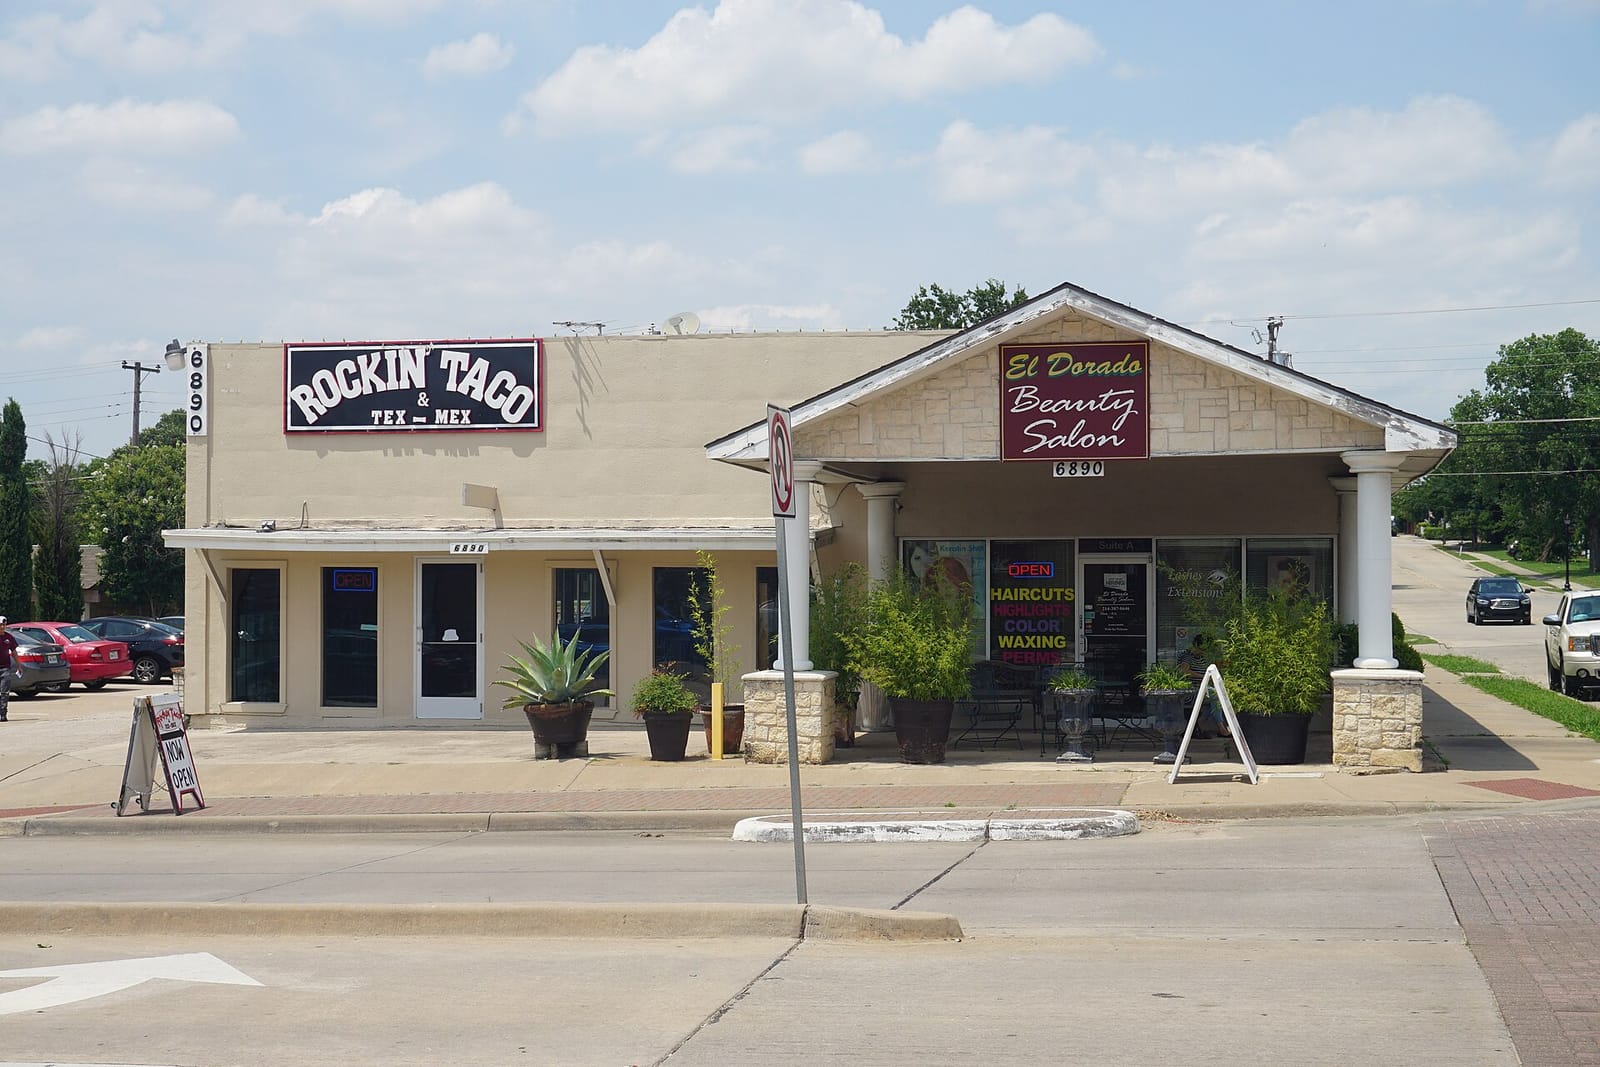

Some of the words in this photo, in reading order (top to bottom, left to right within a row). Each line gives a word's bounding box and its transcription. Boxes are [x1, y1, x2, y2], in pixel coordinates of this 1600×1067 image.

[1006, 354, 1039, 380] El
[1047, 352, 1142, 377] Dorado
[190, 350, 203, 432] 6890
[440, 350, 534, 424] TACO
[417, 392, 430, 407] &
[1008, 385, 1138, 431] Beauty
[371, 410, 406, 424] TEX
[435, 409, 471, 424] MEX
[1022, 419, 1126, 453] Salon
[1056, 462, 1102, 476] 6890
[454, 544, 485, 552] 6890
[1098, 541, 1124, 550] Suite
[1126, 542, 1134, 550] A
[1008, 564, 1051, 576] OPEN
[336, 574, 372, 587] OPEN
[991, 588, 1075, 601] HAIRCUTS
[993, 604, 1071, 616] HIGHLIGHTS
[1004, 620, 1060, 633] COLOR
[998, 636, 1066, 649] WAXING
[1002, 652, 1061, 664] PERMS
[166, 740, 185, 763] NOW
[172, 768, 195, 788] OPEN
